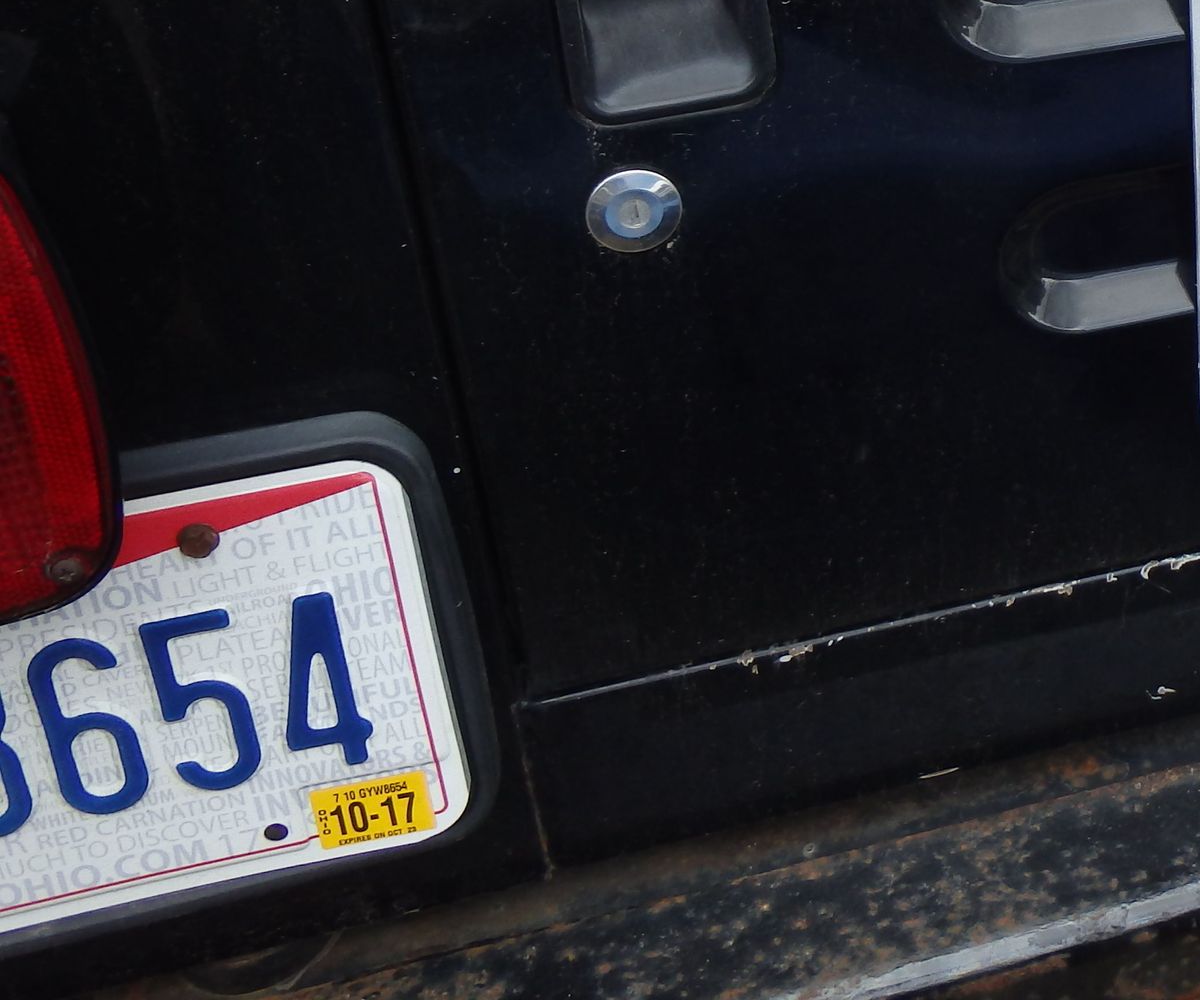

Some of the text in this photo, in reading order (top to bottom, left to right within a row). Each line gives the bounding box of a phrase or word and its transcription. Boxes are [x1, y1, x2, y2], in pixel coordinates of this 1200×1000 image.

[232, 533, 276, 561] OF
[286, 526, 313, 551] IT
[328, 514, 382, 544] ALL
[330, 791, 415, 836] 10-17
[344, 790, 356, 801] 10
[358, 781, 408, 799] GYW8654
